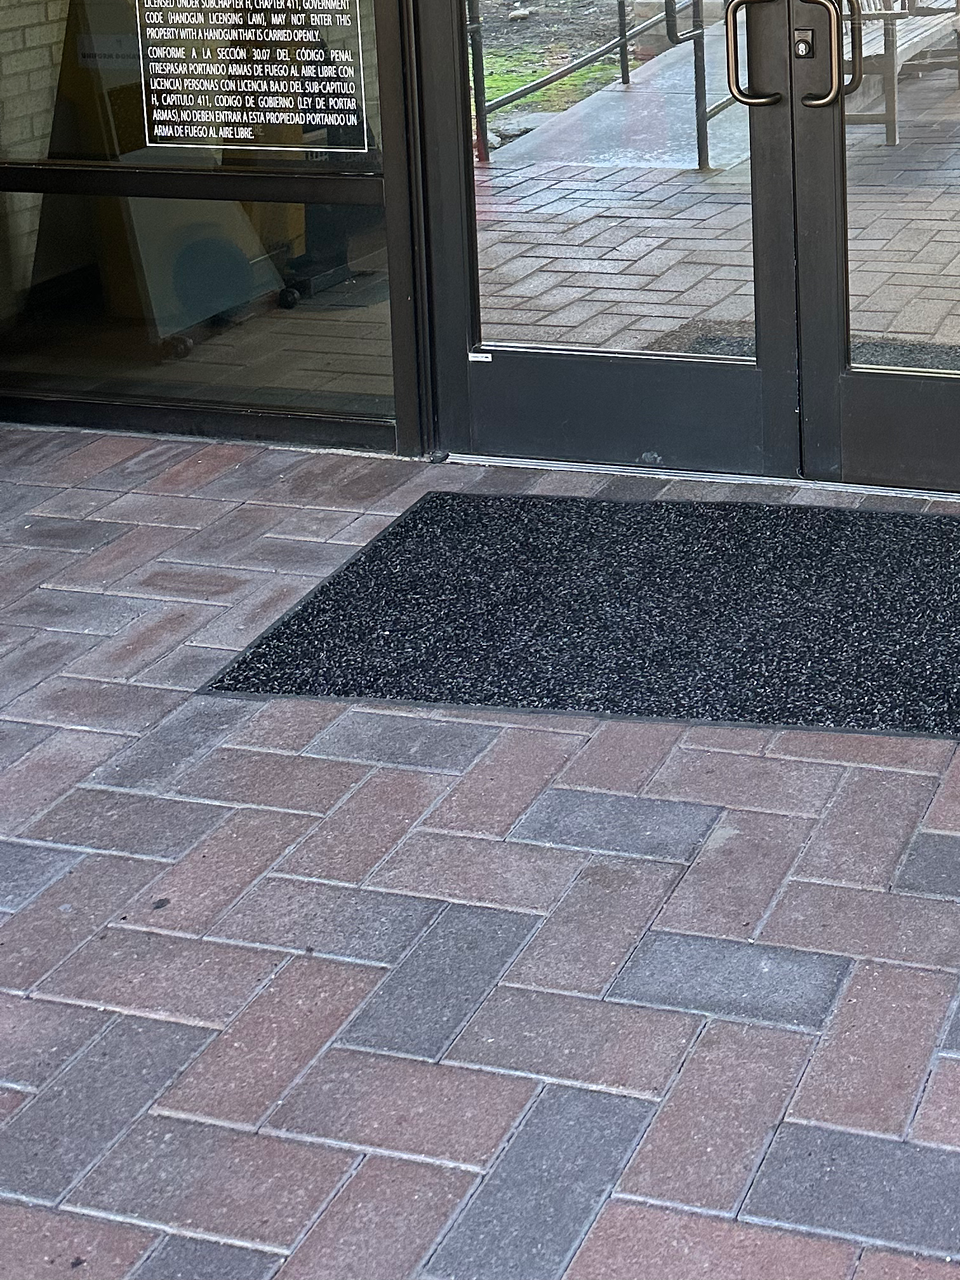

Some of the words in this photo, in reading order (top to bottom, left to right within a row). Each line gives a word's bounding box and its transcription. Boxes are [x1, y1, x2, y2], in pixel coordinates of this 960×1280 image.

[145, 12, 163, 23] CODE
[167, 12, 204, 24] (HANDGUN
[208, 12, 242, 24] LICENSING
[247, 13, 266, 25] LAW),
[271, 13, 286, 25] MAY
[290, 13, 305, 25] NOT
[310, 13, 331, 25] ENTER
[335, 14, 350, 25] THIS
[147, 47, 185, 58] CONFORME
[191, 47, 196, 58] A
[202, 47, 211, 59] LA
[252, 48, 270, 60] 30.07
[276, 48, 290, 60] DEL
[330, 49, 352, 61] PENAL
[151, 94, 158, 106] H,
[161, 94, 194, 106] CAPITULO
[197, 95, 211, 107] 411,
[214, 95, 242, 107] CODIGO
[245, 96, 254, 107] DE
[258, 96, 294, 108] GOBIERNO
[297, 97, 312, 109] (LEY
[315, 97, 325, 109] DE
[328, 97, 356, 109] PORTAR
